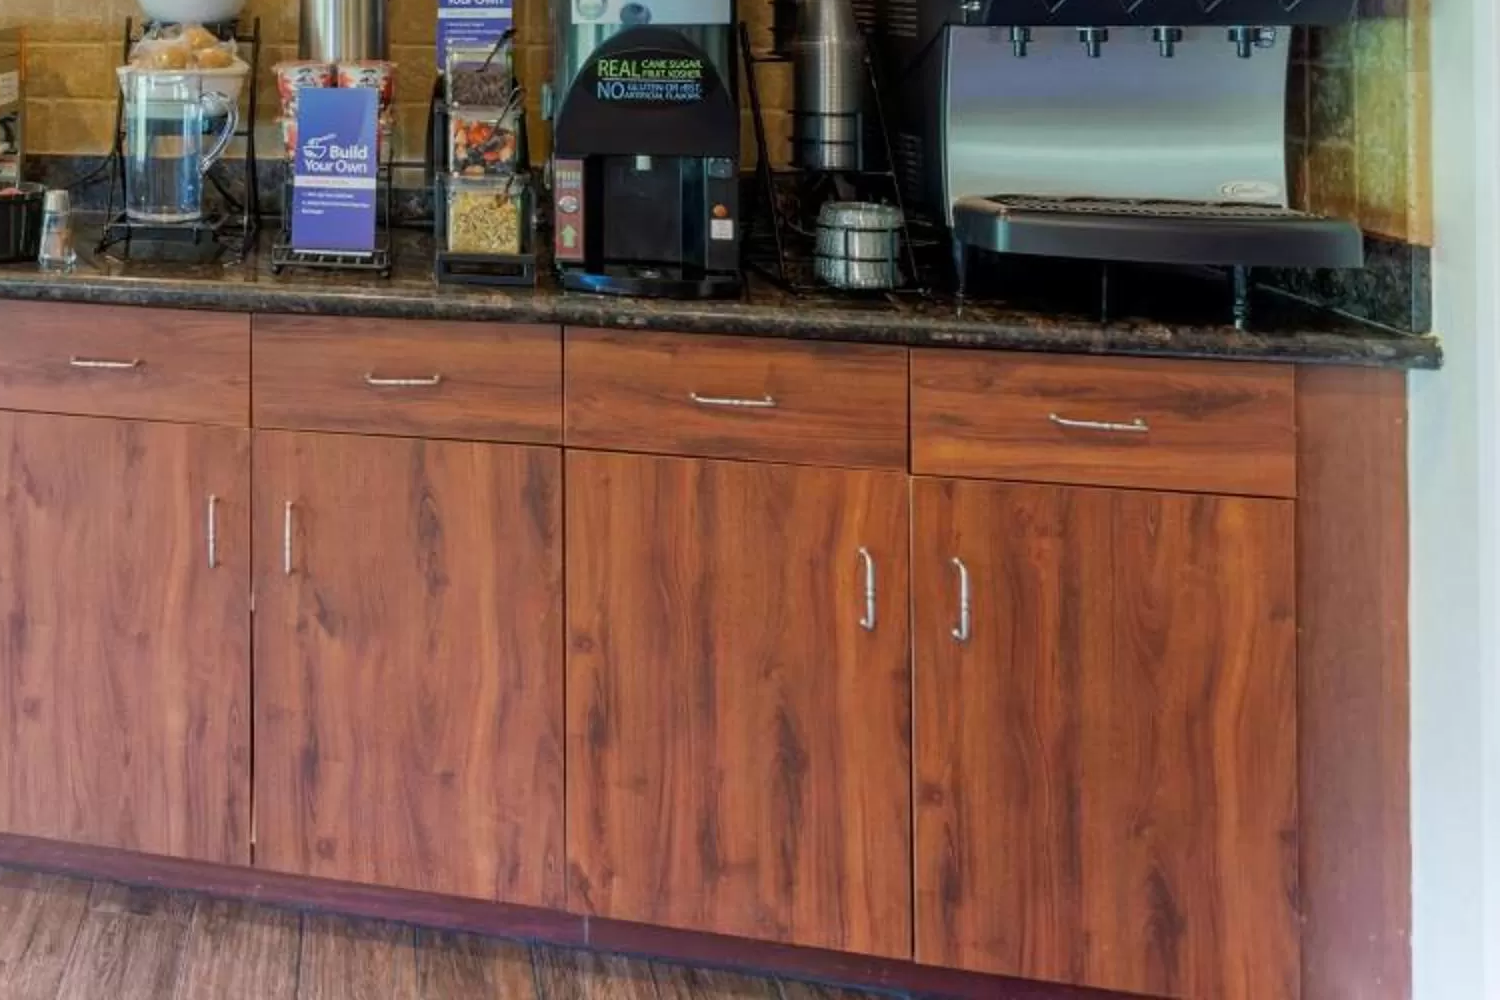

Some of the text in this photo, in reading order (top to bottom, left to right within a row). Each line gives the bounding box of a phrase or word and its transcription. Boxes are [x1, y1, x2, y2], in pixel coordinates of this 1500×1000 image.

[597, 59, 640, 78] REAL
[641, 59, 668, 69] CANE
[597, 81, 625, 99] NO
[329, 144, 368, 160] Build
[304, 159, 368, 174] Your Own
